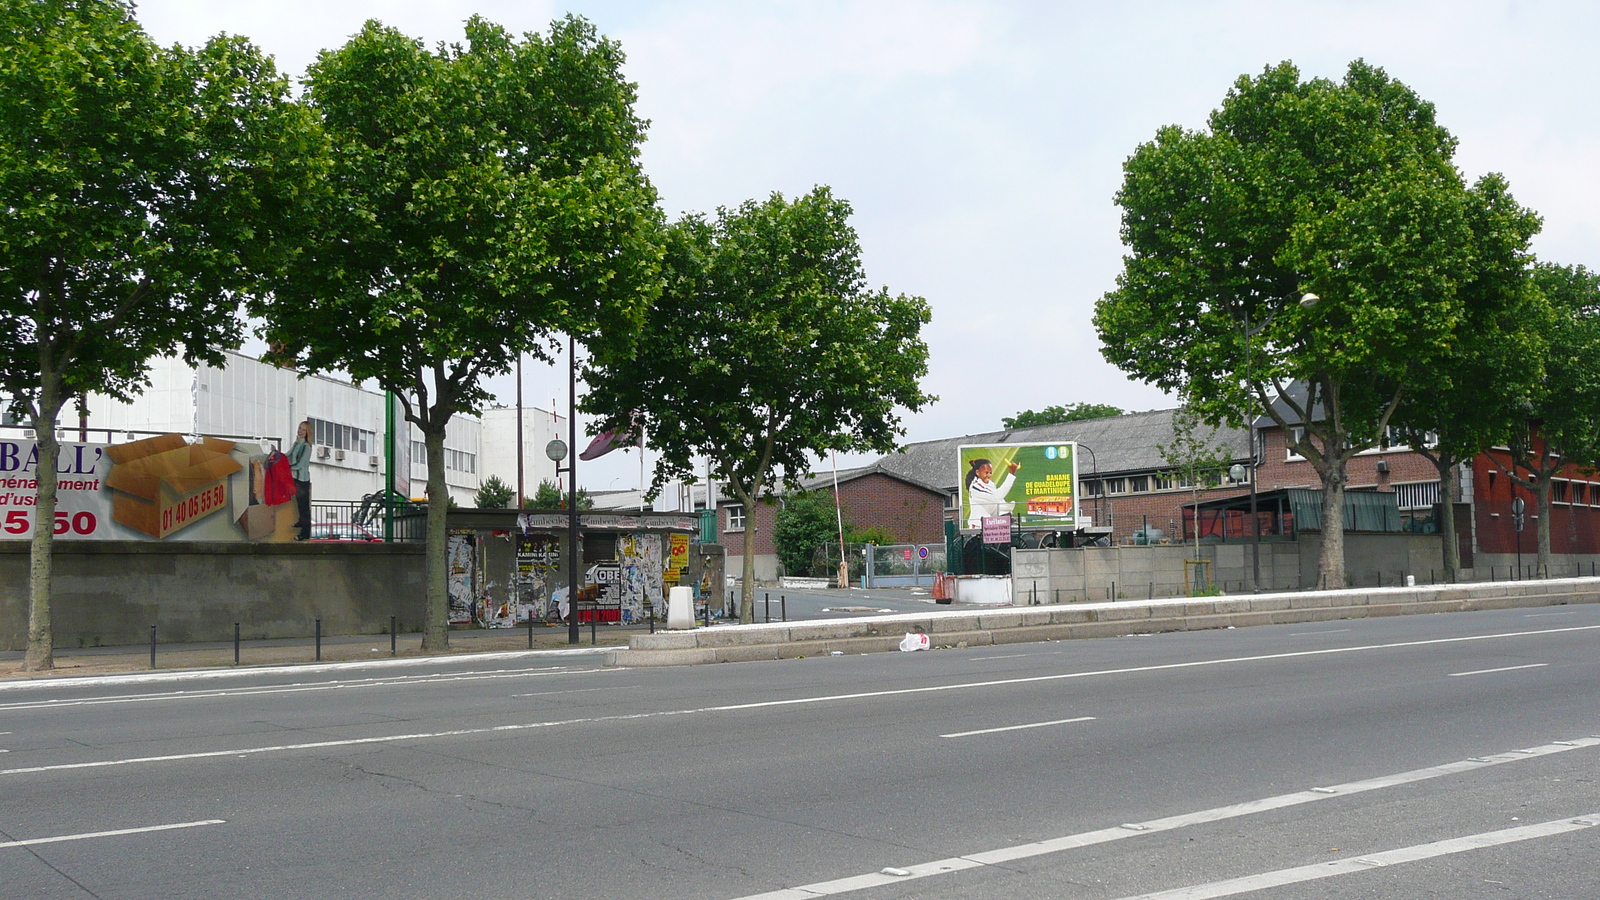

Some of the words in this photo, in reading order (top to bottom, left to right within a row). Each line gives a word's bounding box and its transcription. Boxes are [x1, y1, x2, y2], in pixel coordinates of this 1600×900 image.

[1034, 487, 1071, 495] MARTINIQUE
[163, 507, 173, 530] 01
[176, 501, 186, 523] 40
[189, 495, 198, 518] 05
[202, 490, 211, 512] 55
[214, 485, 223, 506] 50
[601, 609, 621, 621] 2007
